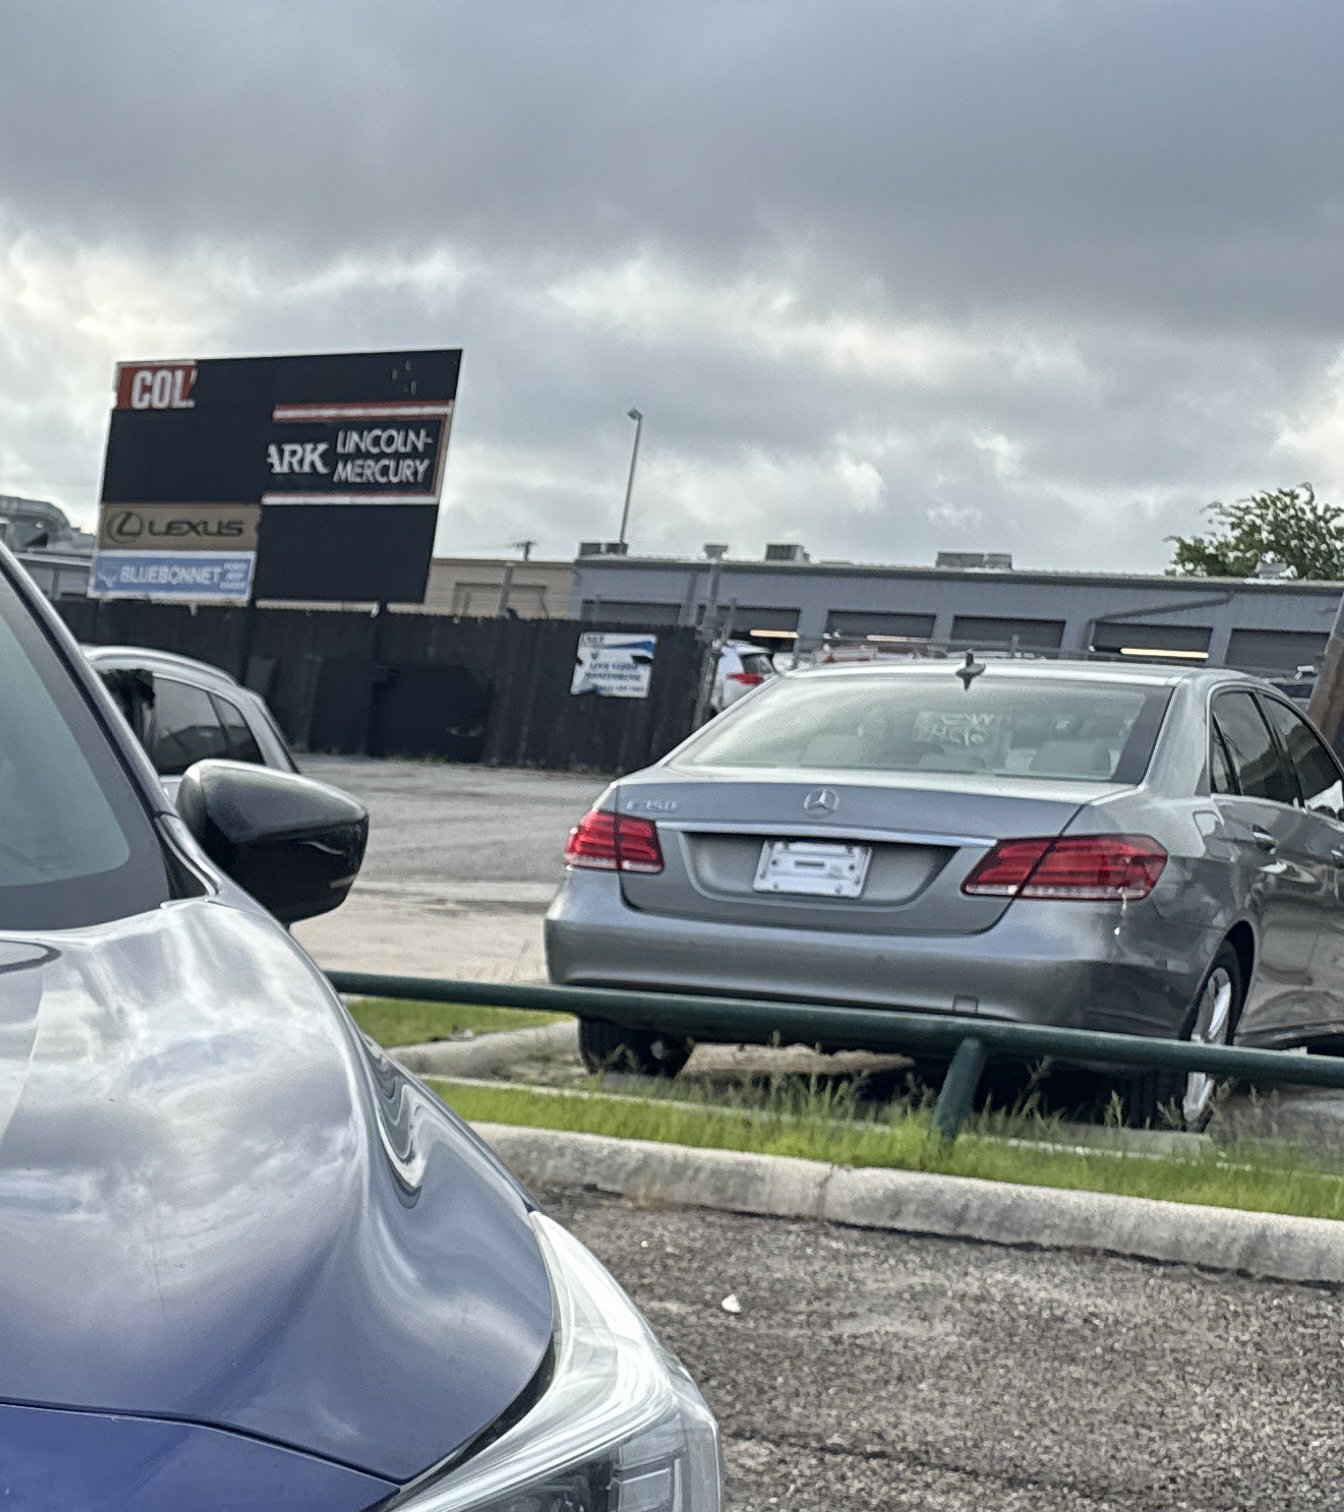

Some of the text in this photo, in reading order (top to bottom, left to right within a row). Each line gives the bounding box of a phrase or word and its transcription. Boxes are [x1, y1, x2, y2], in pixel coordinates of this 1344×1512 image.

[131, 369, 197, 409] COL
[336, 428, 433, 454] LINCOLN-
[332, 458, 430, 484] MERCURY
[148, 520, 244, 537] LEXUS
[119, 564, 222, 585] BLUEBONNET
